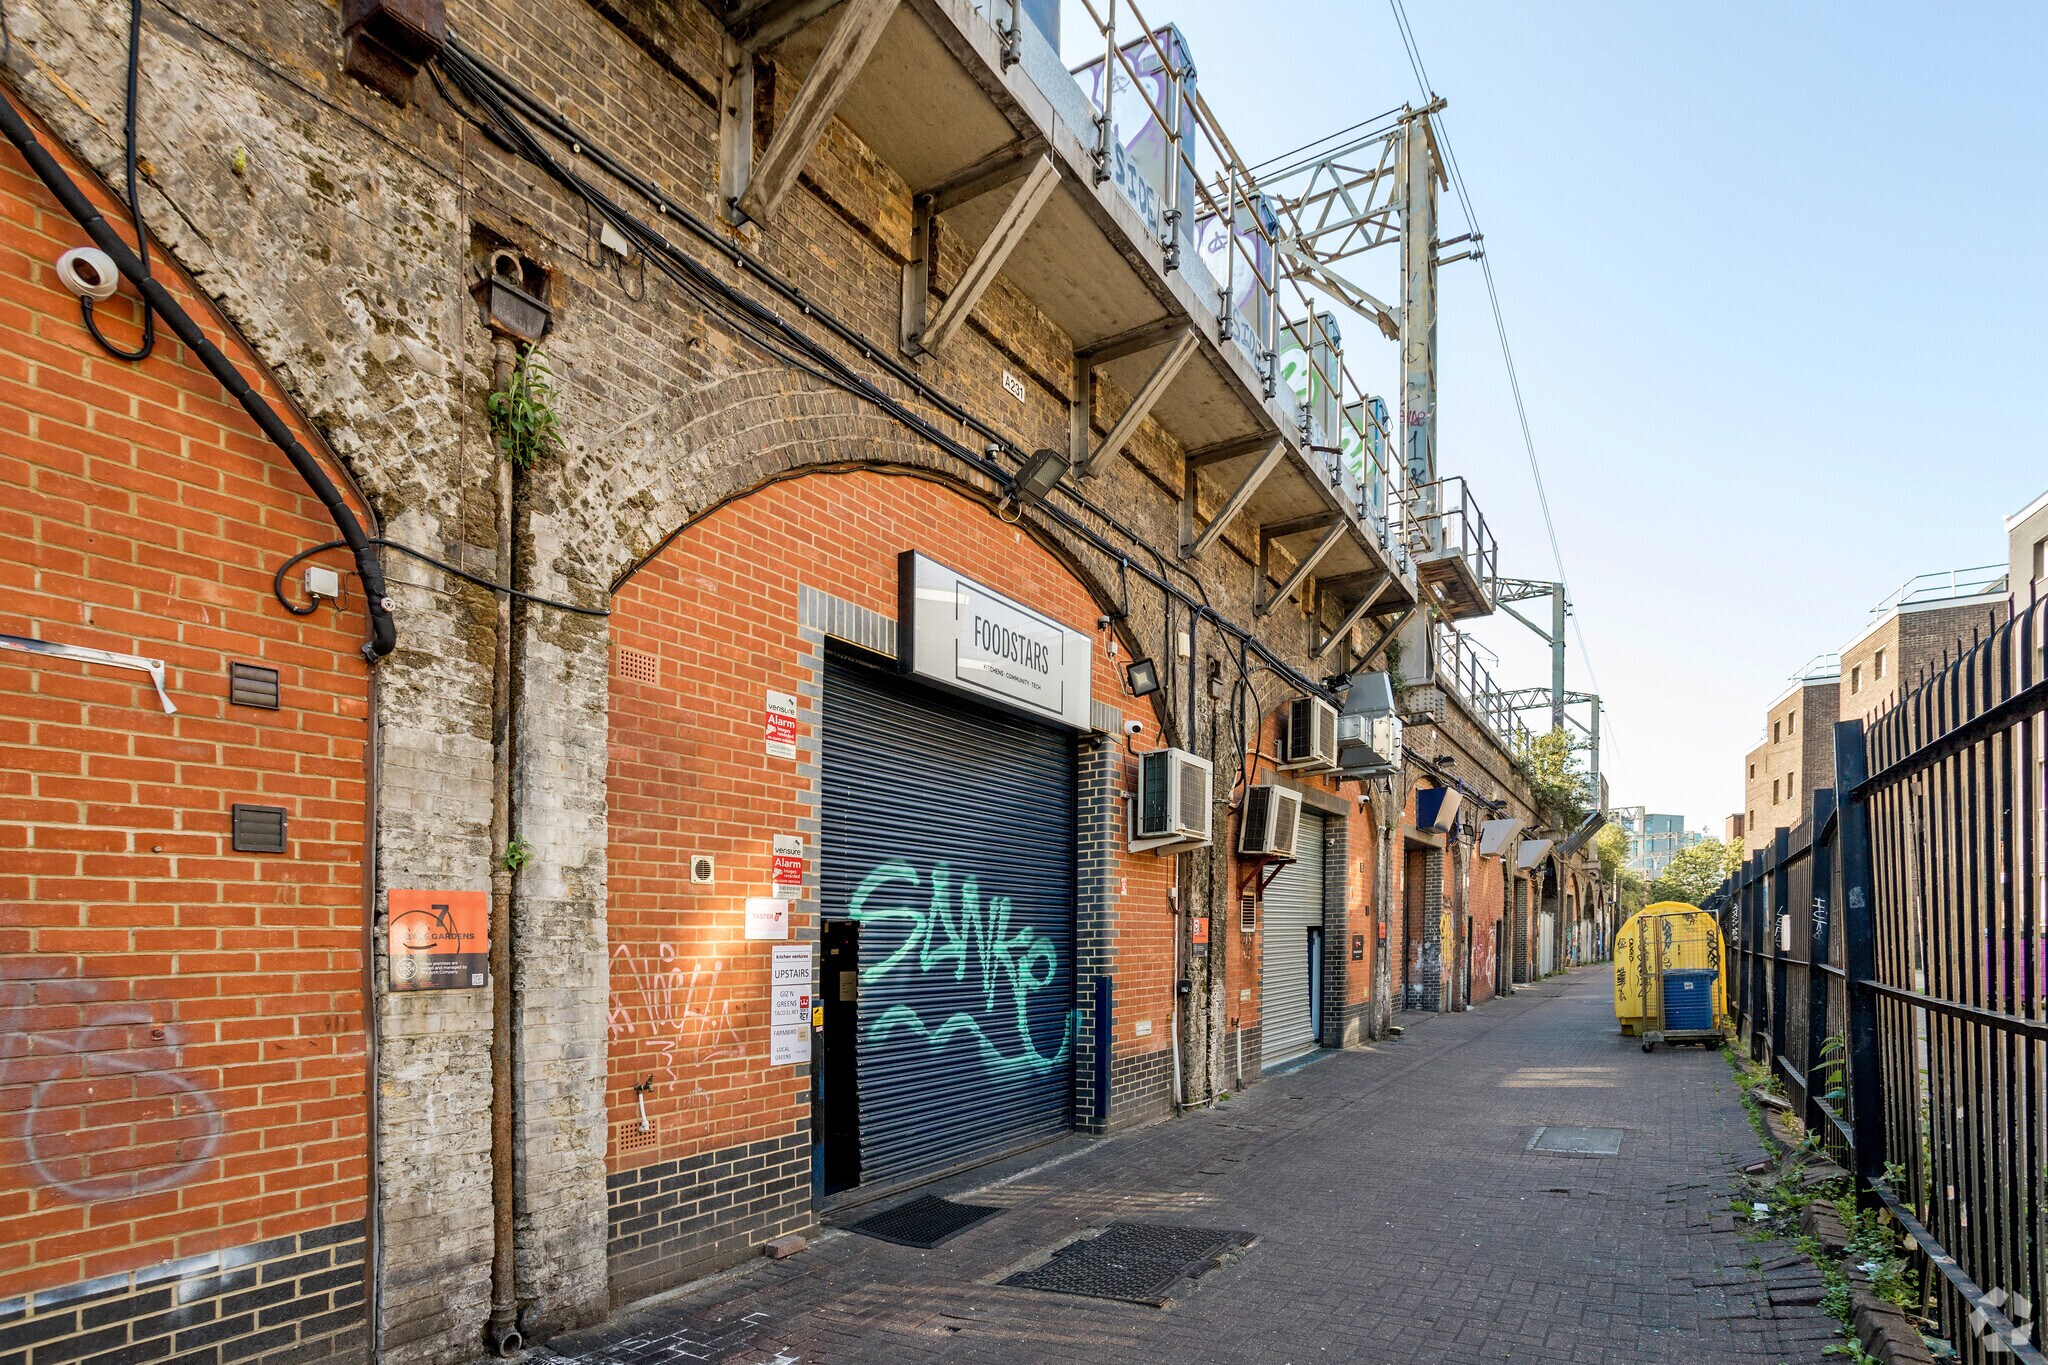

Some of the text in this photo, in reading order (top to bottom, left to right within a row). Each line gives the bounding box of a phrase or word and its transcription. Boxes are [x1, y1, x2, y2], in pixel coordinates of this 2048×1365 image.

[1005, 375, 1023, 399] A231
[975, 615, 1049, 675] FOODSTARS
[984, 664, 1041, 690] KITCHENS COMMUNITY TECH
[768, 704, 795, 715] verisure
[768, 714, 795, 729] Alarm
[775, 847, 801, 855] verisure
[775, 858, 801, 868] Alarm
[431, 904, 449, 927] 7
[775, 969, 809, 979] UPSTAIRS
